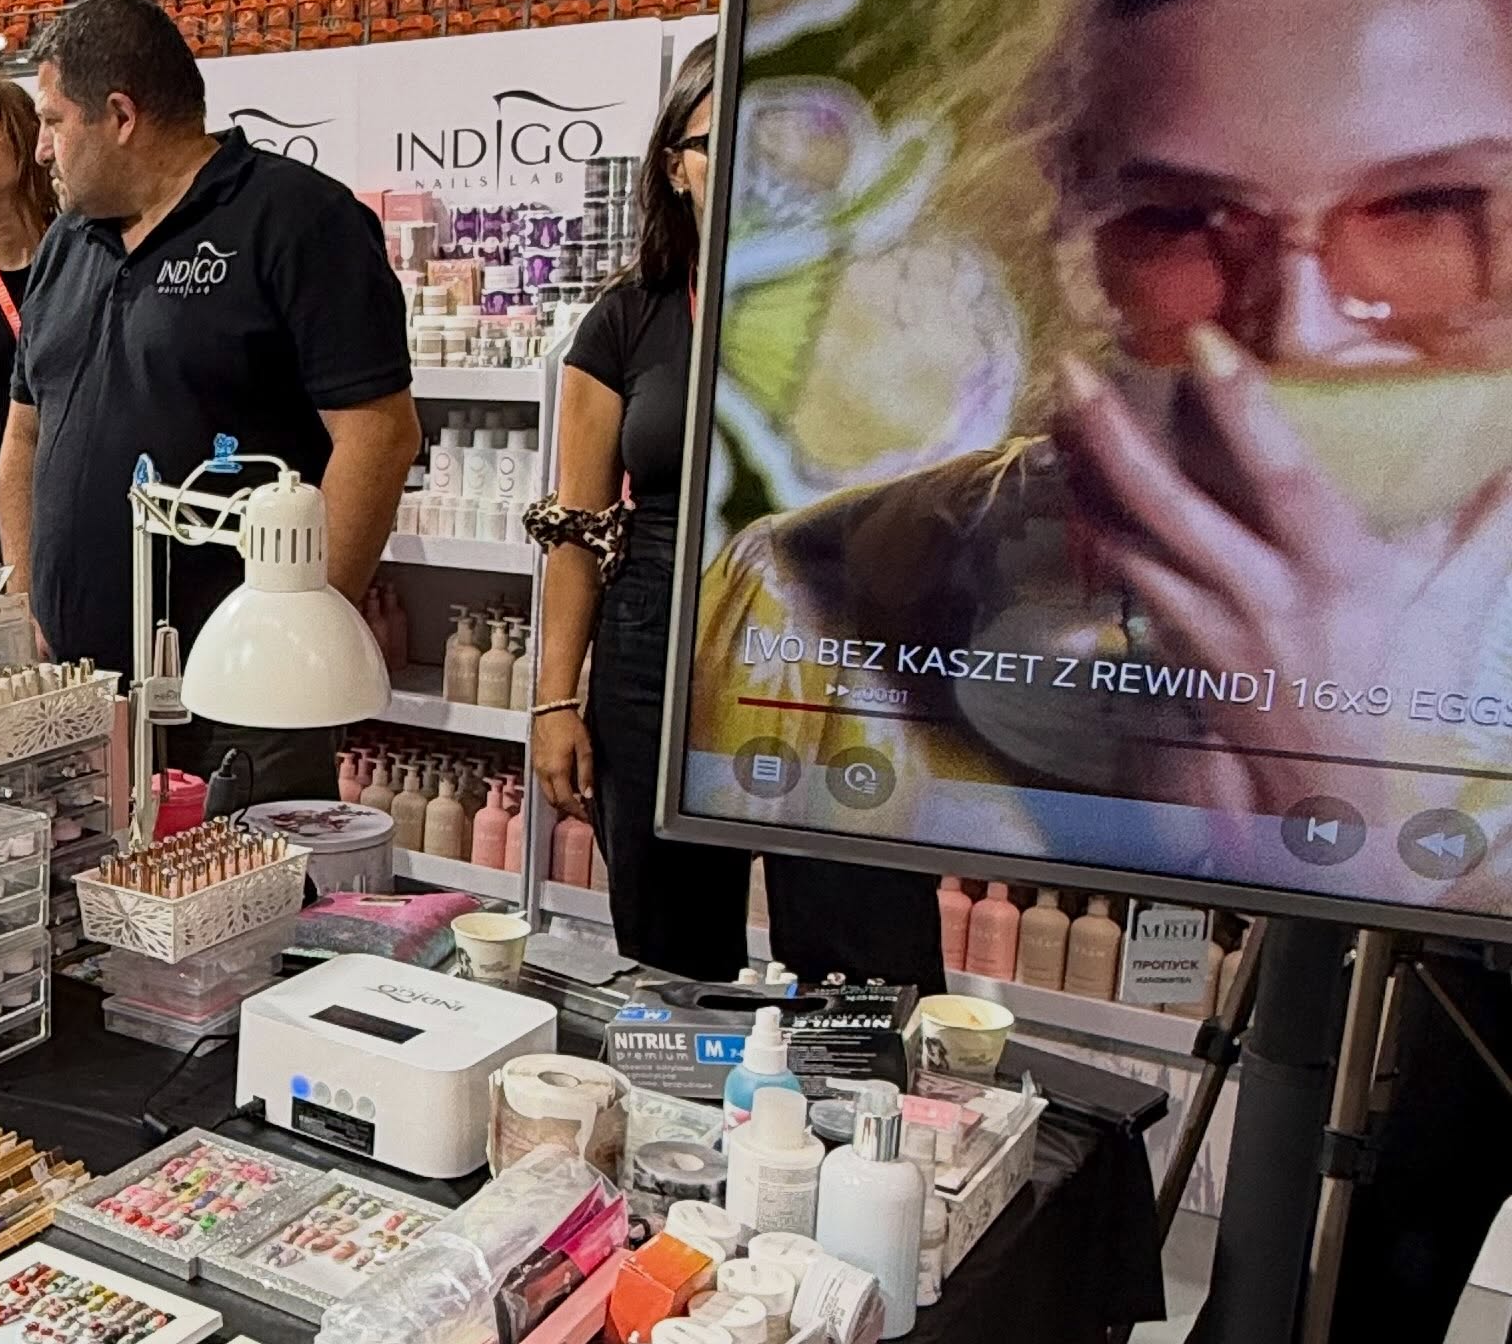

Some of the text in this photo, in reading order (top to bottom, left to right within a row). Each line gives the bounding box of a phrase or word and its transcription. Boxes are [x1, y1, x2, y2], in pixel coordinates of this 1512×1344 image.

[396, 119, 603, 173] INDIGO
[415, 171, 564, 190] NAILS LAB
[156, 257, 228, 285] INDIGO
[816, 638, 887, 671] BEZ
[896, 645, 1044, 685] KASZET
[1051, 657, 1078, 689] Z
[1090, 659, 1277, 714] REWIND]
[1291, 677, 1394, 716] 16x9
[1132, 959, 1200, 971] ПРОПУСК
[614, 1031, 688, 1051] NITRILE
[704, 1039, 725, 1058] M
[615, 1050, 689, 1062] premium
